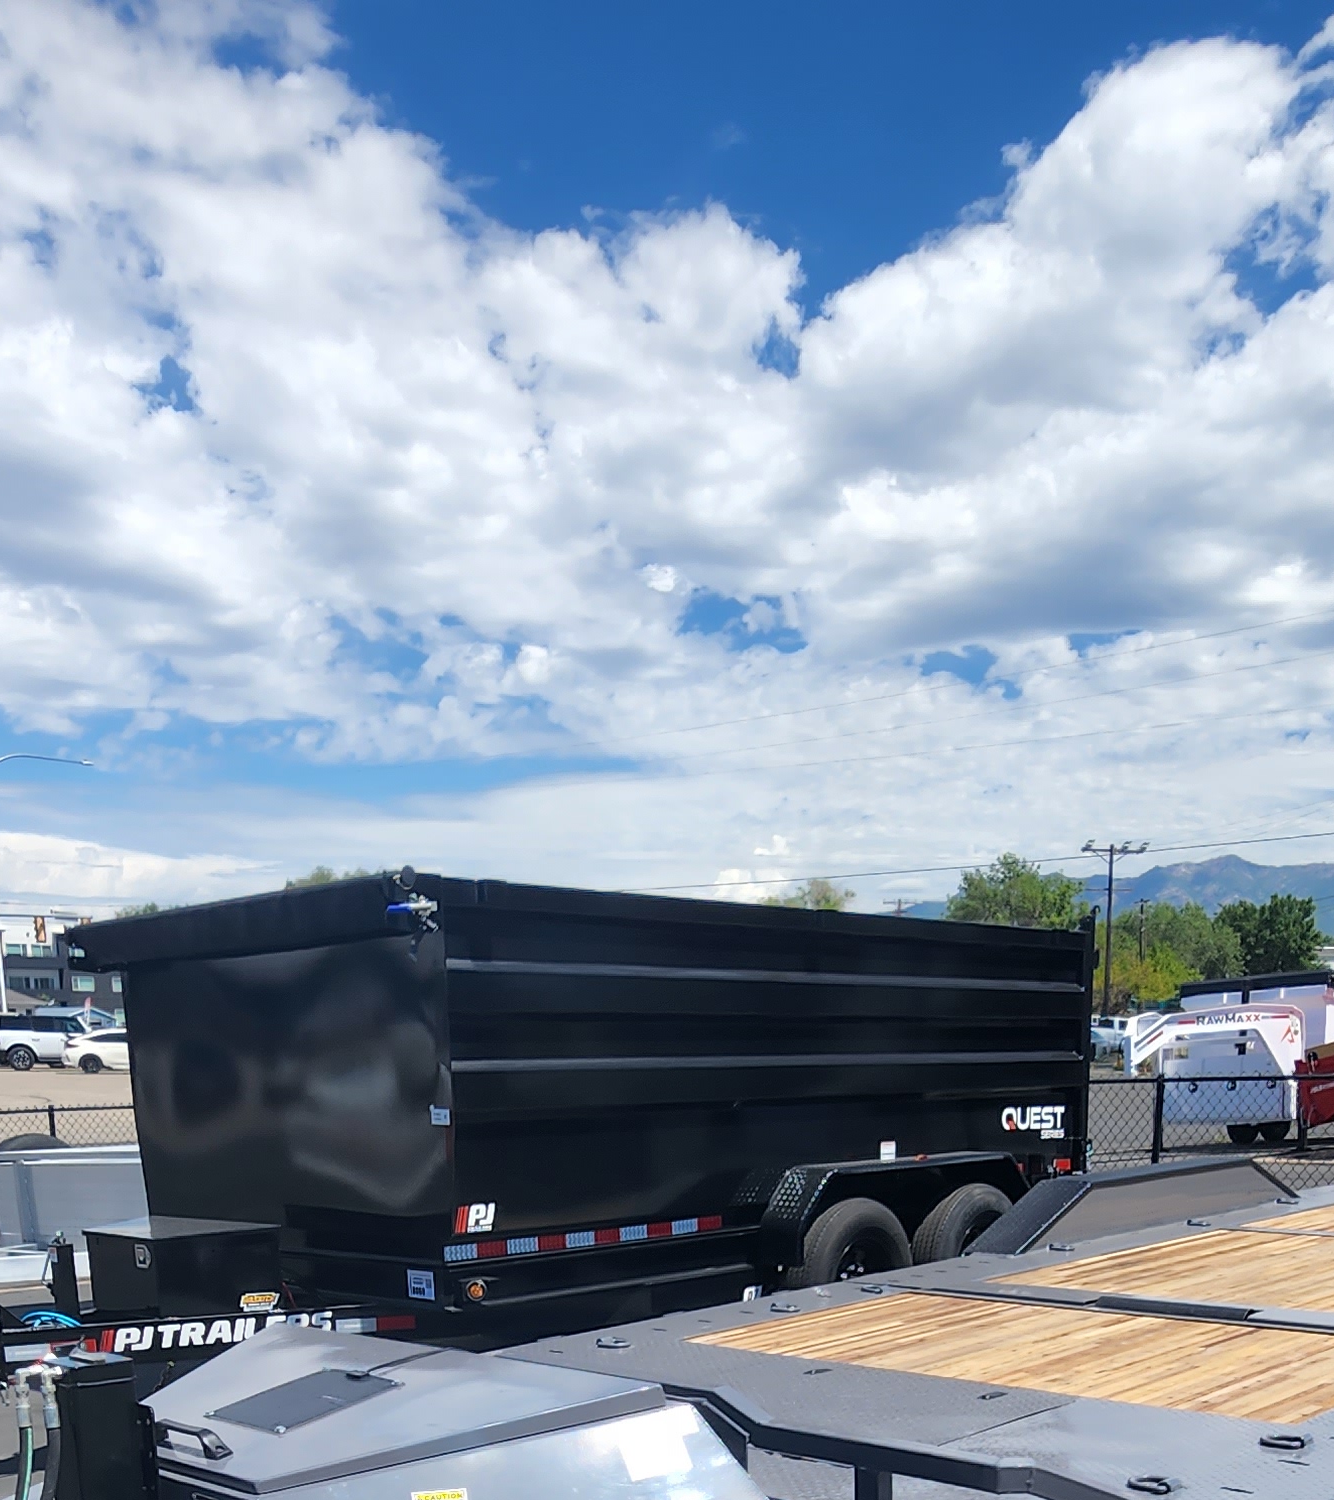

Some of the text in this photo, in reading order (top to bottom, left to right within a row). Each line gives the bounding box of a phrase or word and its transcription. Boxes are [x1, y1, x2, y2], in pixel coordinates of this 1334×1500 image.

[1001, 1105, 1065, 1131] QUEST
[468, 1203, 496, 1226] PJ
[114, 1326, 154, 1353] PJ
